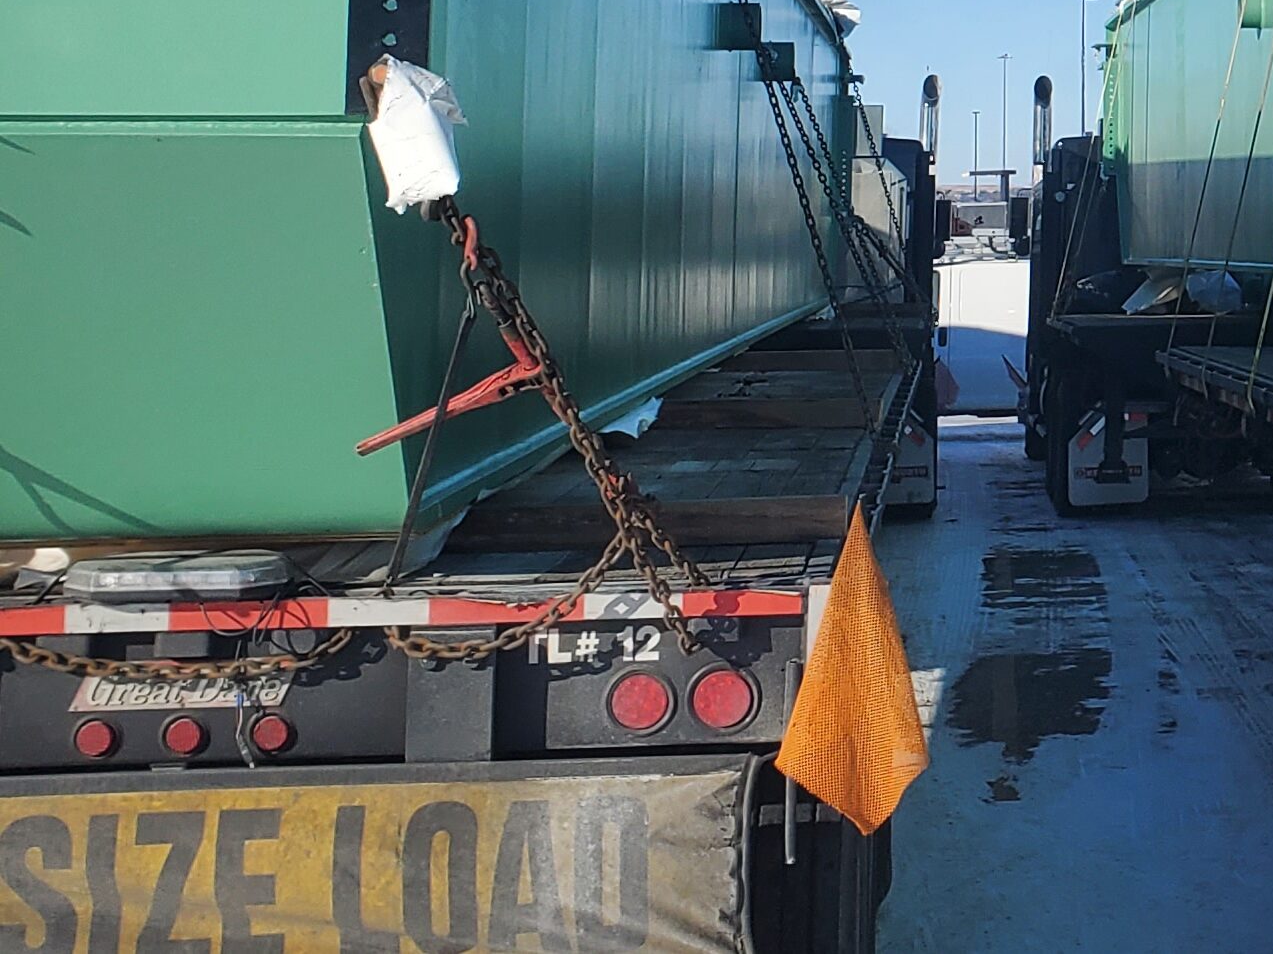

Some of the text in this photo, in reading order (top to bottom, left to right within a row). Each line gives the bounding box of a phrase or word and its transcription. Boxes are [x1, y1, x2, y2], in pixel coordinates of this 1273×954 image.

[528, 624, 661, 665] TL# 12
[86, 675, 190, 707] Great
[331, 794, 650, 954] LOAD
